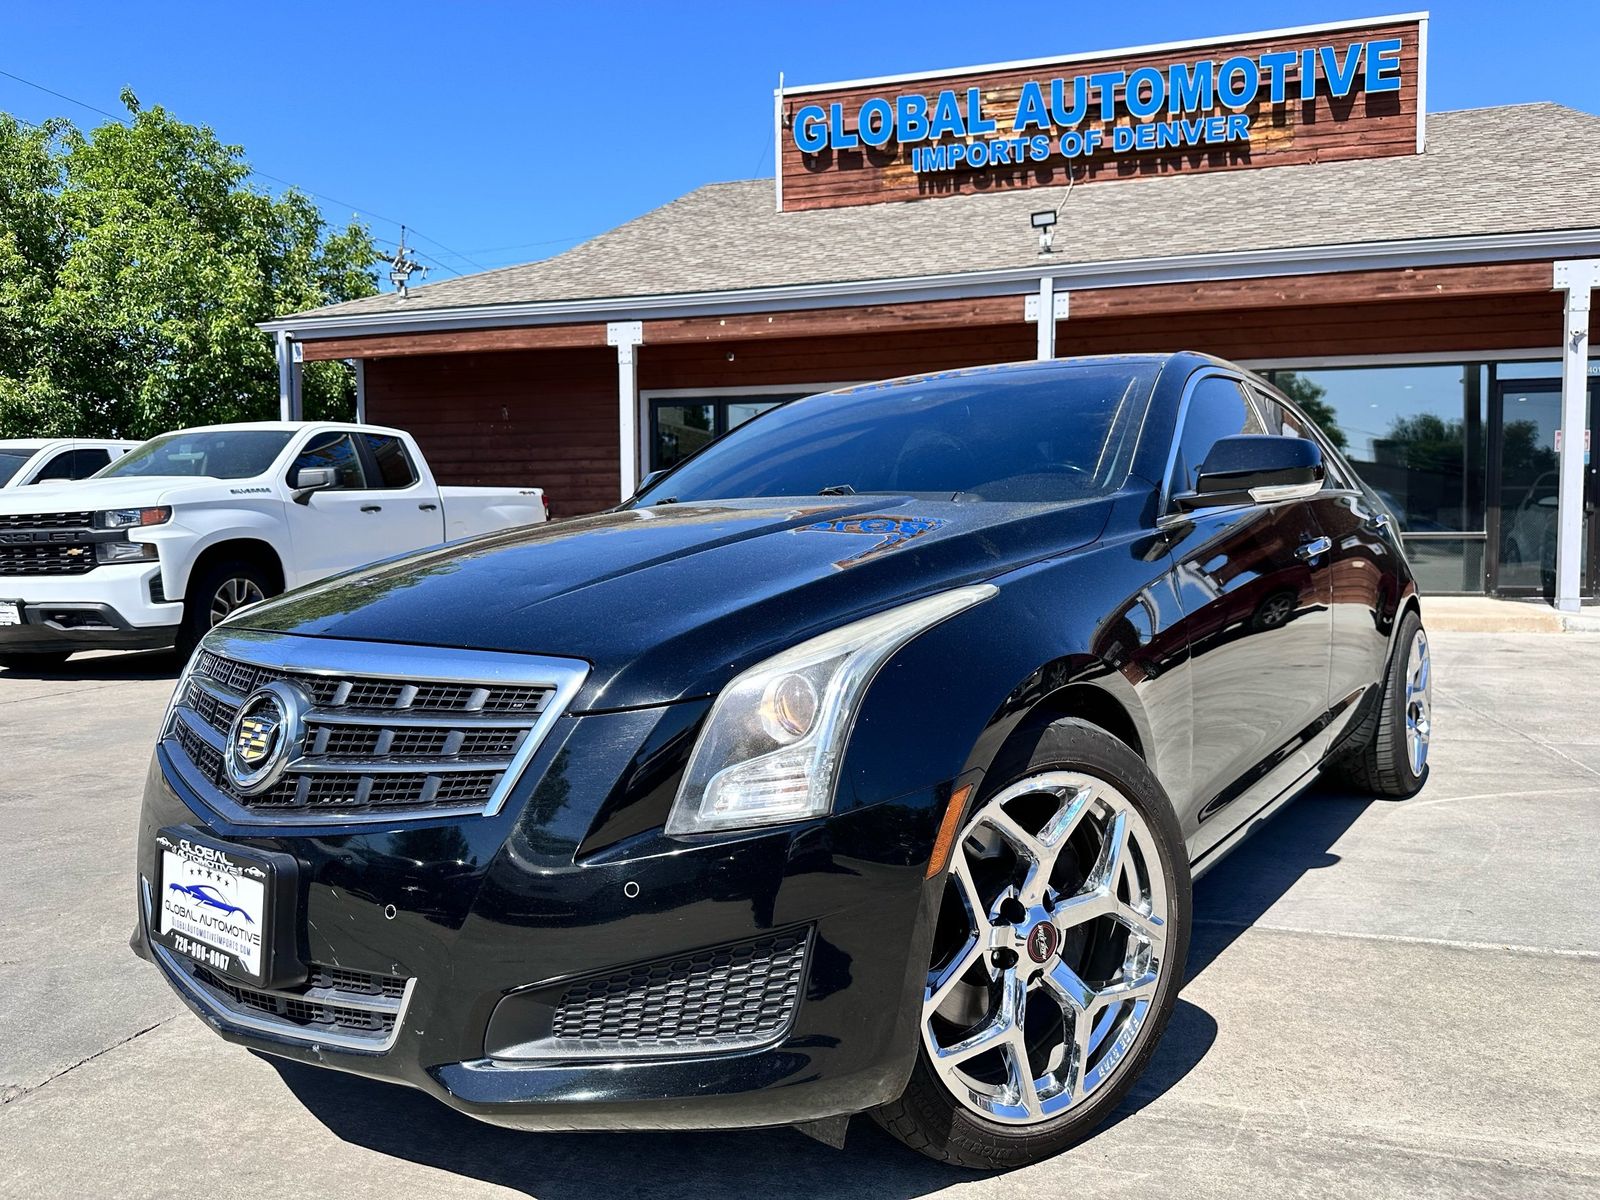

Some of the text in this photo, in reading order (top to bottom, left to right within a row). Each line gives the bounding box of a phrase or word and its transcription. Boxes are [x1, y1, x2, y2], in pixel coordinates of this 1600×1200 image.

[792, 38, 1403, 155] GLOBAL AUTOMOTIVE
[911, 114, 1251, 174] IMPORTS OF DENVER
[177, 849, 239, 876] AUTOMOTIVE
[180, 839, 234, 867] GLOBAL
[165, 899, 260, 946] GLOBAL AUTOMOTIVE
